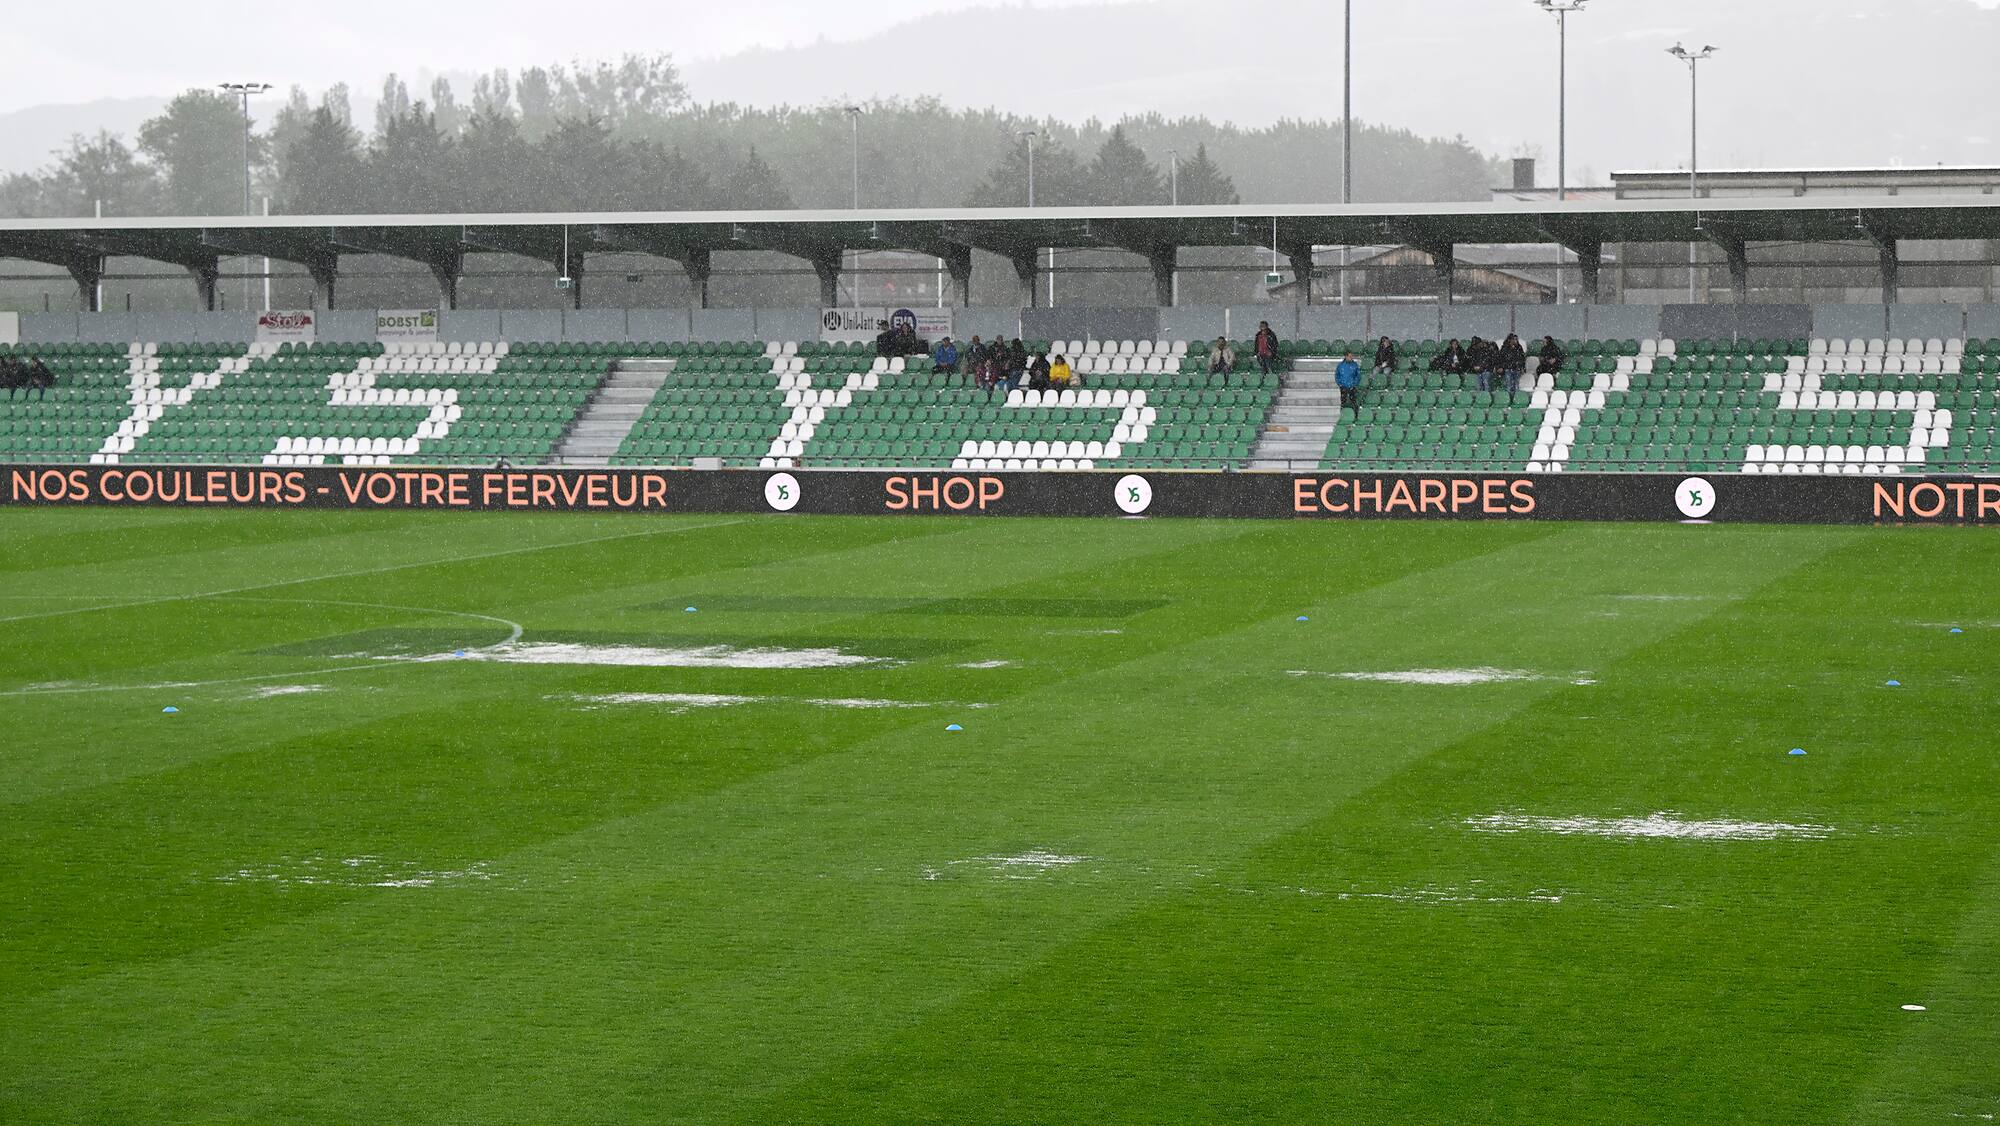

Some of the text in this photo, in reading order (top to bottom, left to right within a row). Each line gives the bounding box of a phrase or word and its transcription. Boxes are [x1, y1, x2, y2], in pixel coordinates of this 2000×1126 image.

[265, 311, 305, 329] Stoll
[378, 316, 419, 327] BOBST
[843, 311, 874, 330] UniWatt
[12, 470, 90, 501] NOS
[99, 470, 306, 502] COULEURS
[340, 472, 470, 504] VOTRE
[483, 473, 668, 507] FERVEUR
[885, 476, 1004, 511] SHOP
[1294, 478, 1536, 513] ECHARPES
[1873, 482, 2000, 517] NOTR
